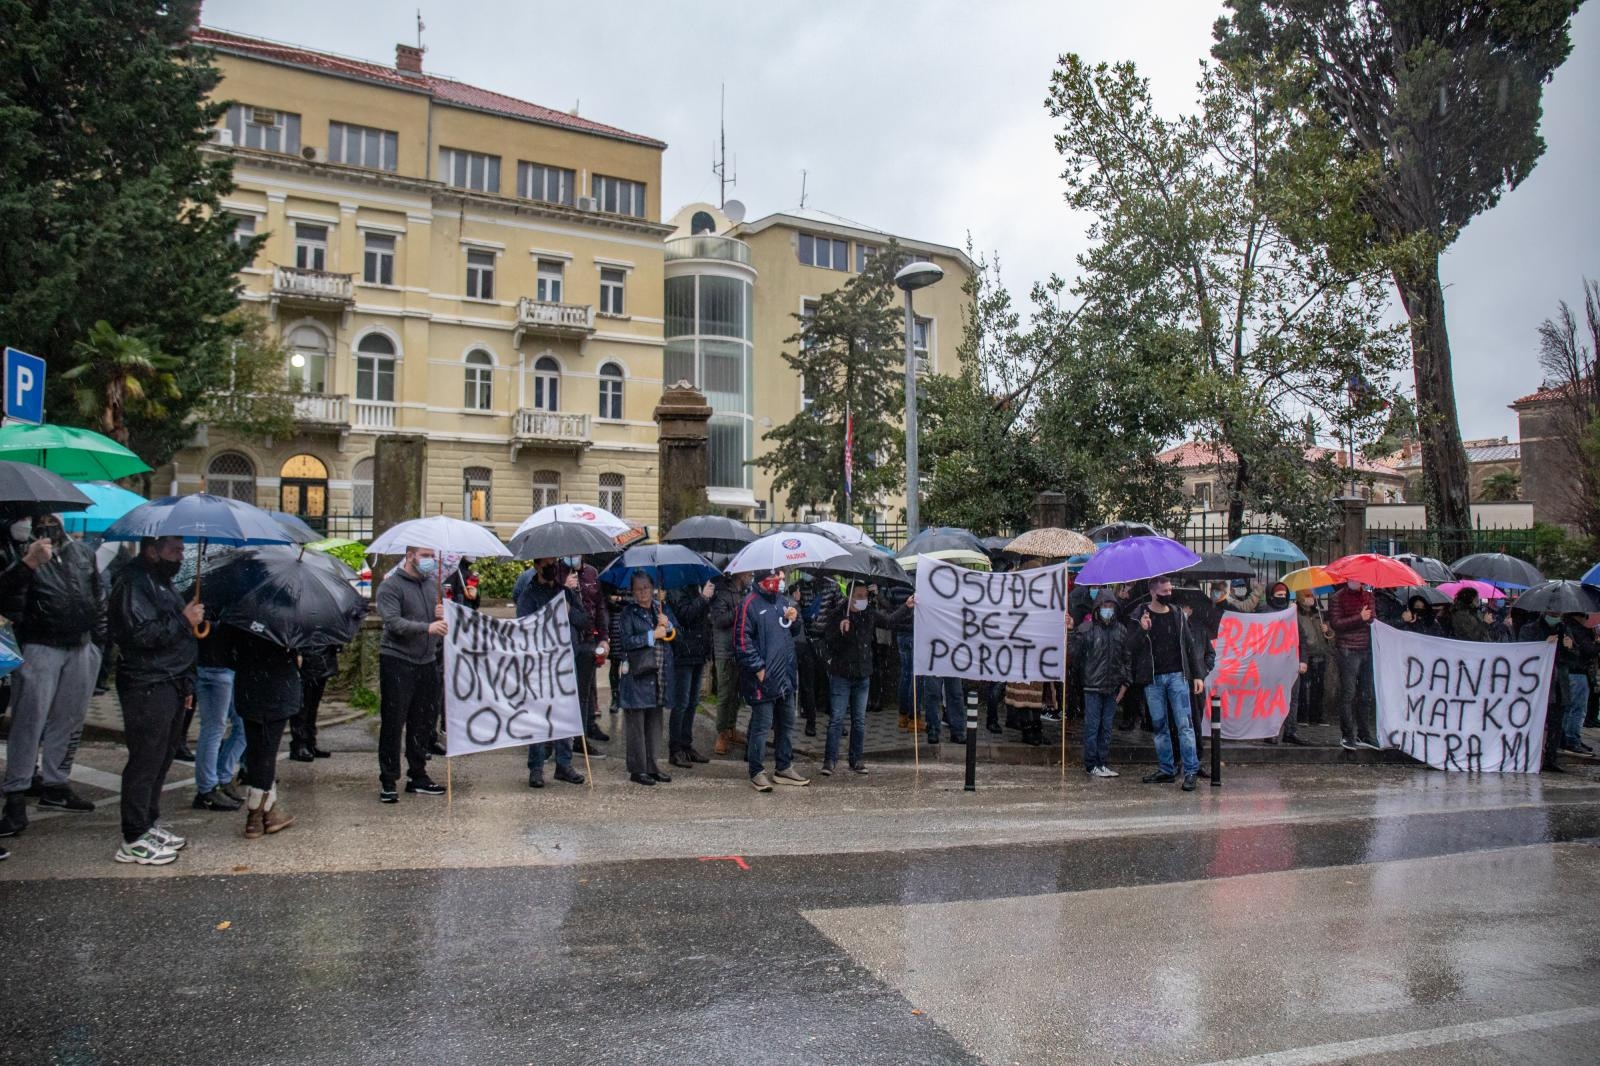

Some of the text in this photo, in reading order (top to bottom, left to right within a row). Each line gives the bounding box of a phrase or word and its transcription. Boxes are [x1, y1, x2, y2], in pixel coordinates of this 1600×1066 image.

[17, 365, 34, 406] P
[929, 565, 1066, 611] OSUĐEN
[961, 607, 1032, 643] BEZ
[1217, 616, 1299, 660] RAVDA
[453, 648, 576, 701] OTVORITE
[928, 638, 1061, 680] POROTE
[1215, 658, 1260, 688] ZA
[1405, 656, 1541, 696] DANAS
[467, 700, 553, 745] OČI
[1406, 694, 1532, 731] MATKO
[1500, 731, 1531, 772] MI
